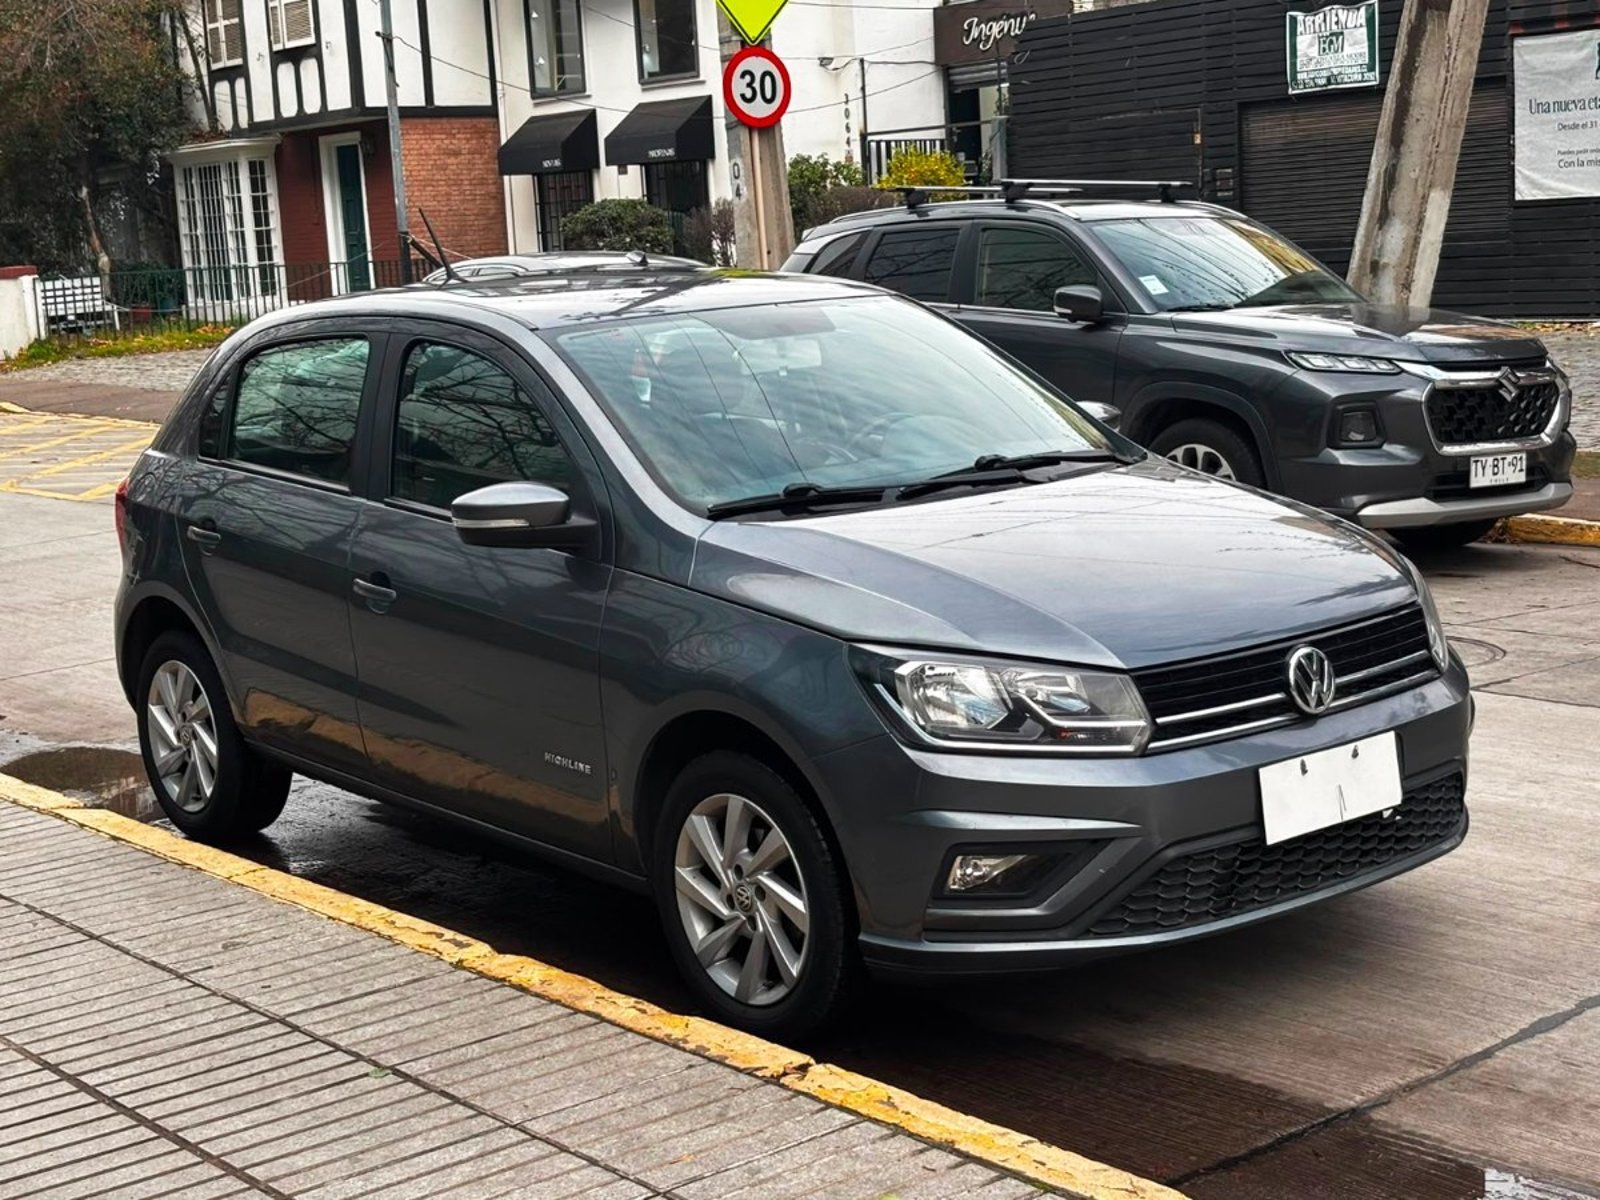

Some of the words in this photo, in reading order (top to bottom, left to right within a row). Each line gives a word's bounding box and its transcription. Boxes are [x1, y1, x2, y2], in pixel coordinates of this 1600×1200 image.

[1297, 6, 1366, 36] ARRIENDA
[739, 69, 777, 105] 30
[1528, 98, 1551, 115] Una
[1552, 99, 1586, 113] nueva
[1557, 122, 1580, 131] Desde
[1581, 121, 1588, 129] el
[1589, 120, 1598, 129] 31
[1558, 158, 1575, 169] Con
[1577, 157, 1585, 168] la
[544, 751, 592, 775] HIGHLINE
